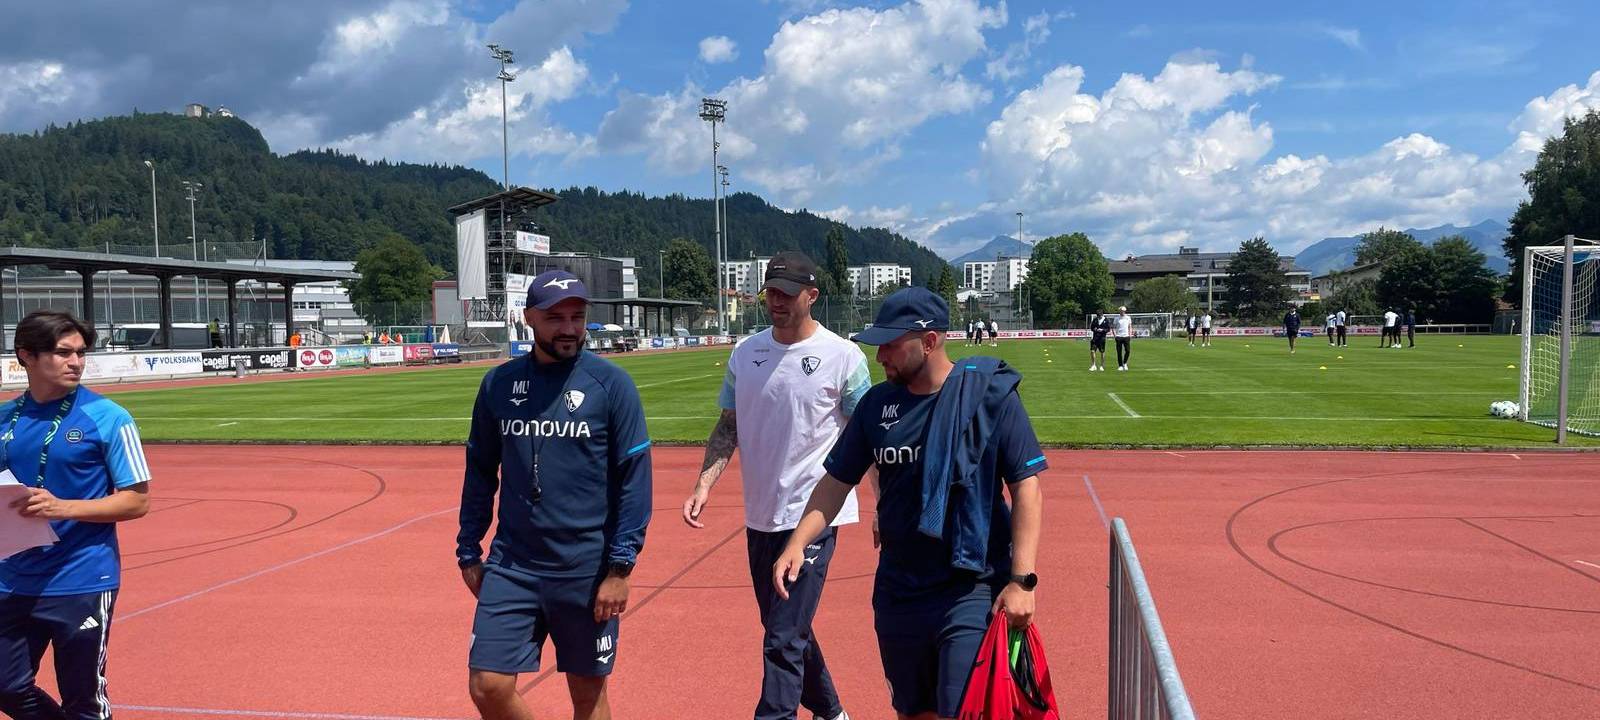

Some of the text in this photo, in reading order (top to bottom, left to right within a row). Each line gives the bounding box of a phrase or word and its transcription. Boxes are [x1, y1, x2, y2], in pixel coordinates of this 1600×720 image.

[160, 356, 202, 365] VOLKSBANK
[203, 354, 229, 369] capelli
[260, 351, 288, 368] capelli
[512, 380, 530, 395] MU
[881, 403, 900, 419] MK
[596, 634, 612, 653] MU
